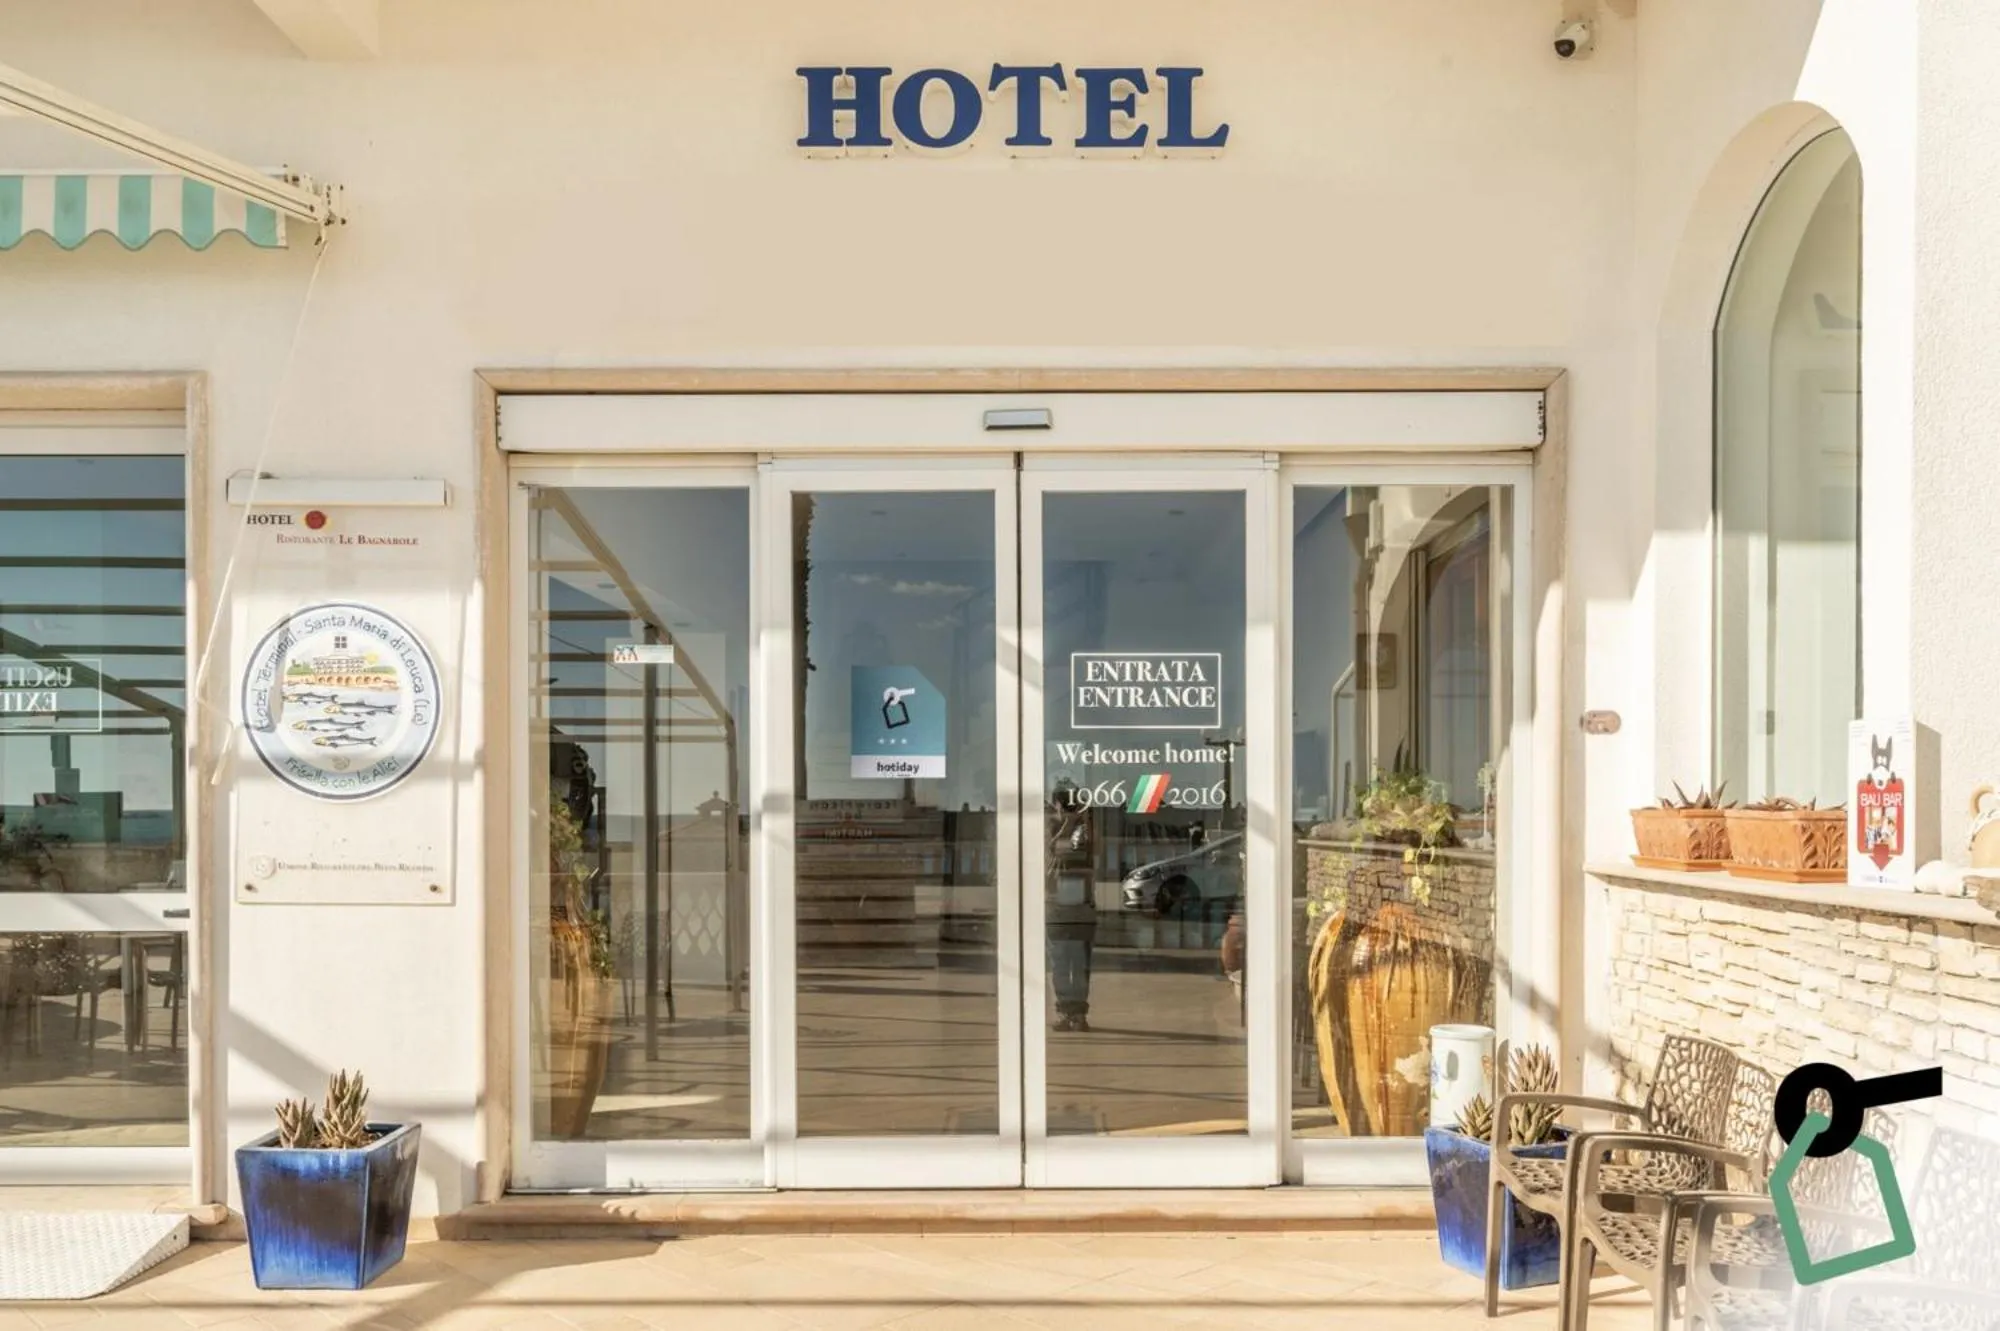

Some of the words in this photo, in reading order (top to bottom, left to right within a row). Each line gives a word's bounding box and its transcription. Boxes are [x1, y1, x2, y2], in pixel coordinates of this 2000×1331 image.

[796, 62, 1229, 149] HOTEL
[247, 513, 295, 526] HOTEL
[304, 614, 346, 634] Santa
[349, 615, 389, 641] Maria
[400, 648, 424, 694] Leuca
[1086, 660, 1207, 682] ENTRATA
[1077, 686, 1216, 708] ENTRANCE
[1056, 742, 1161, 765] Welcome
[1164, 742, 1235, 765] home!
[877, 762, 919, 774] hotiday
[1067, 780, 1126, 814] 1966
[1168, 780, 1227, 806] 2016
[1860, 792, 1881, 806] BAU
[1882, 792, 1903, 807] BAR
